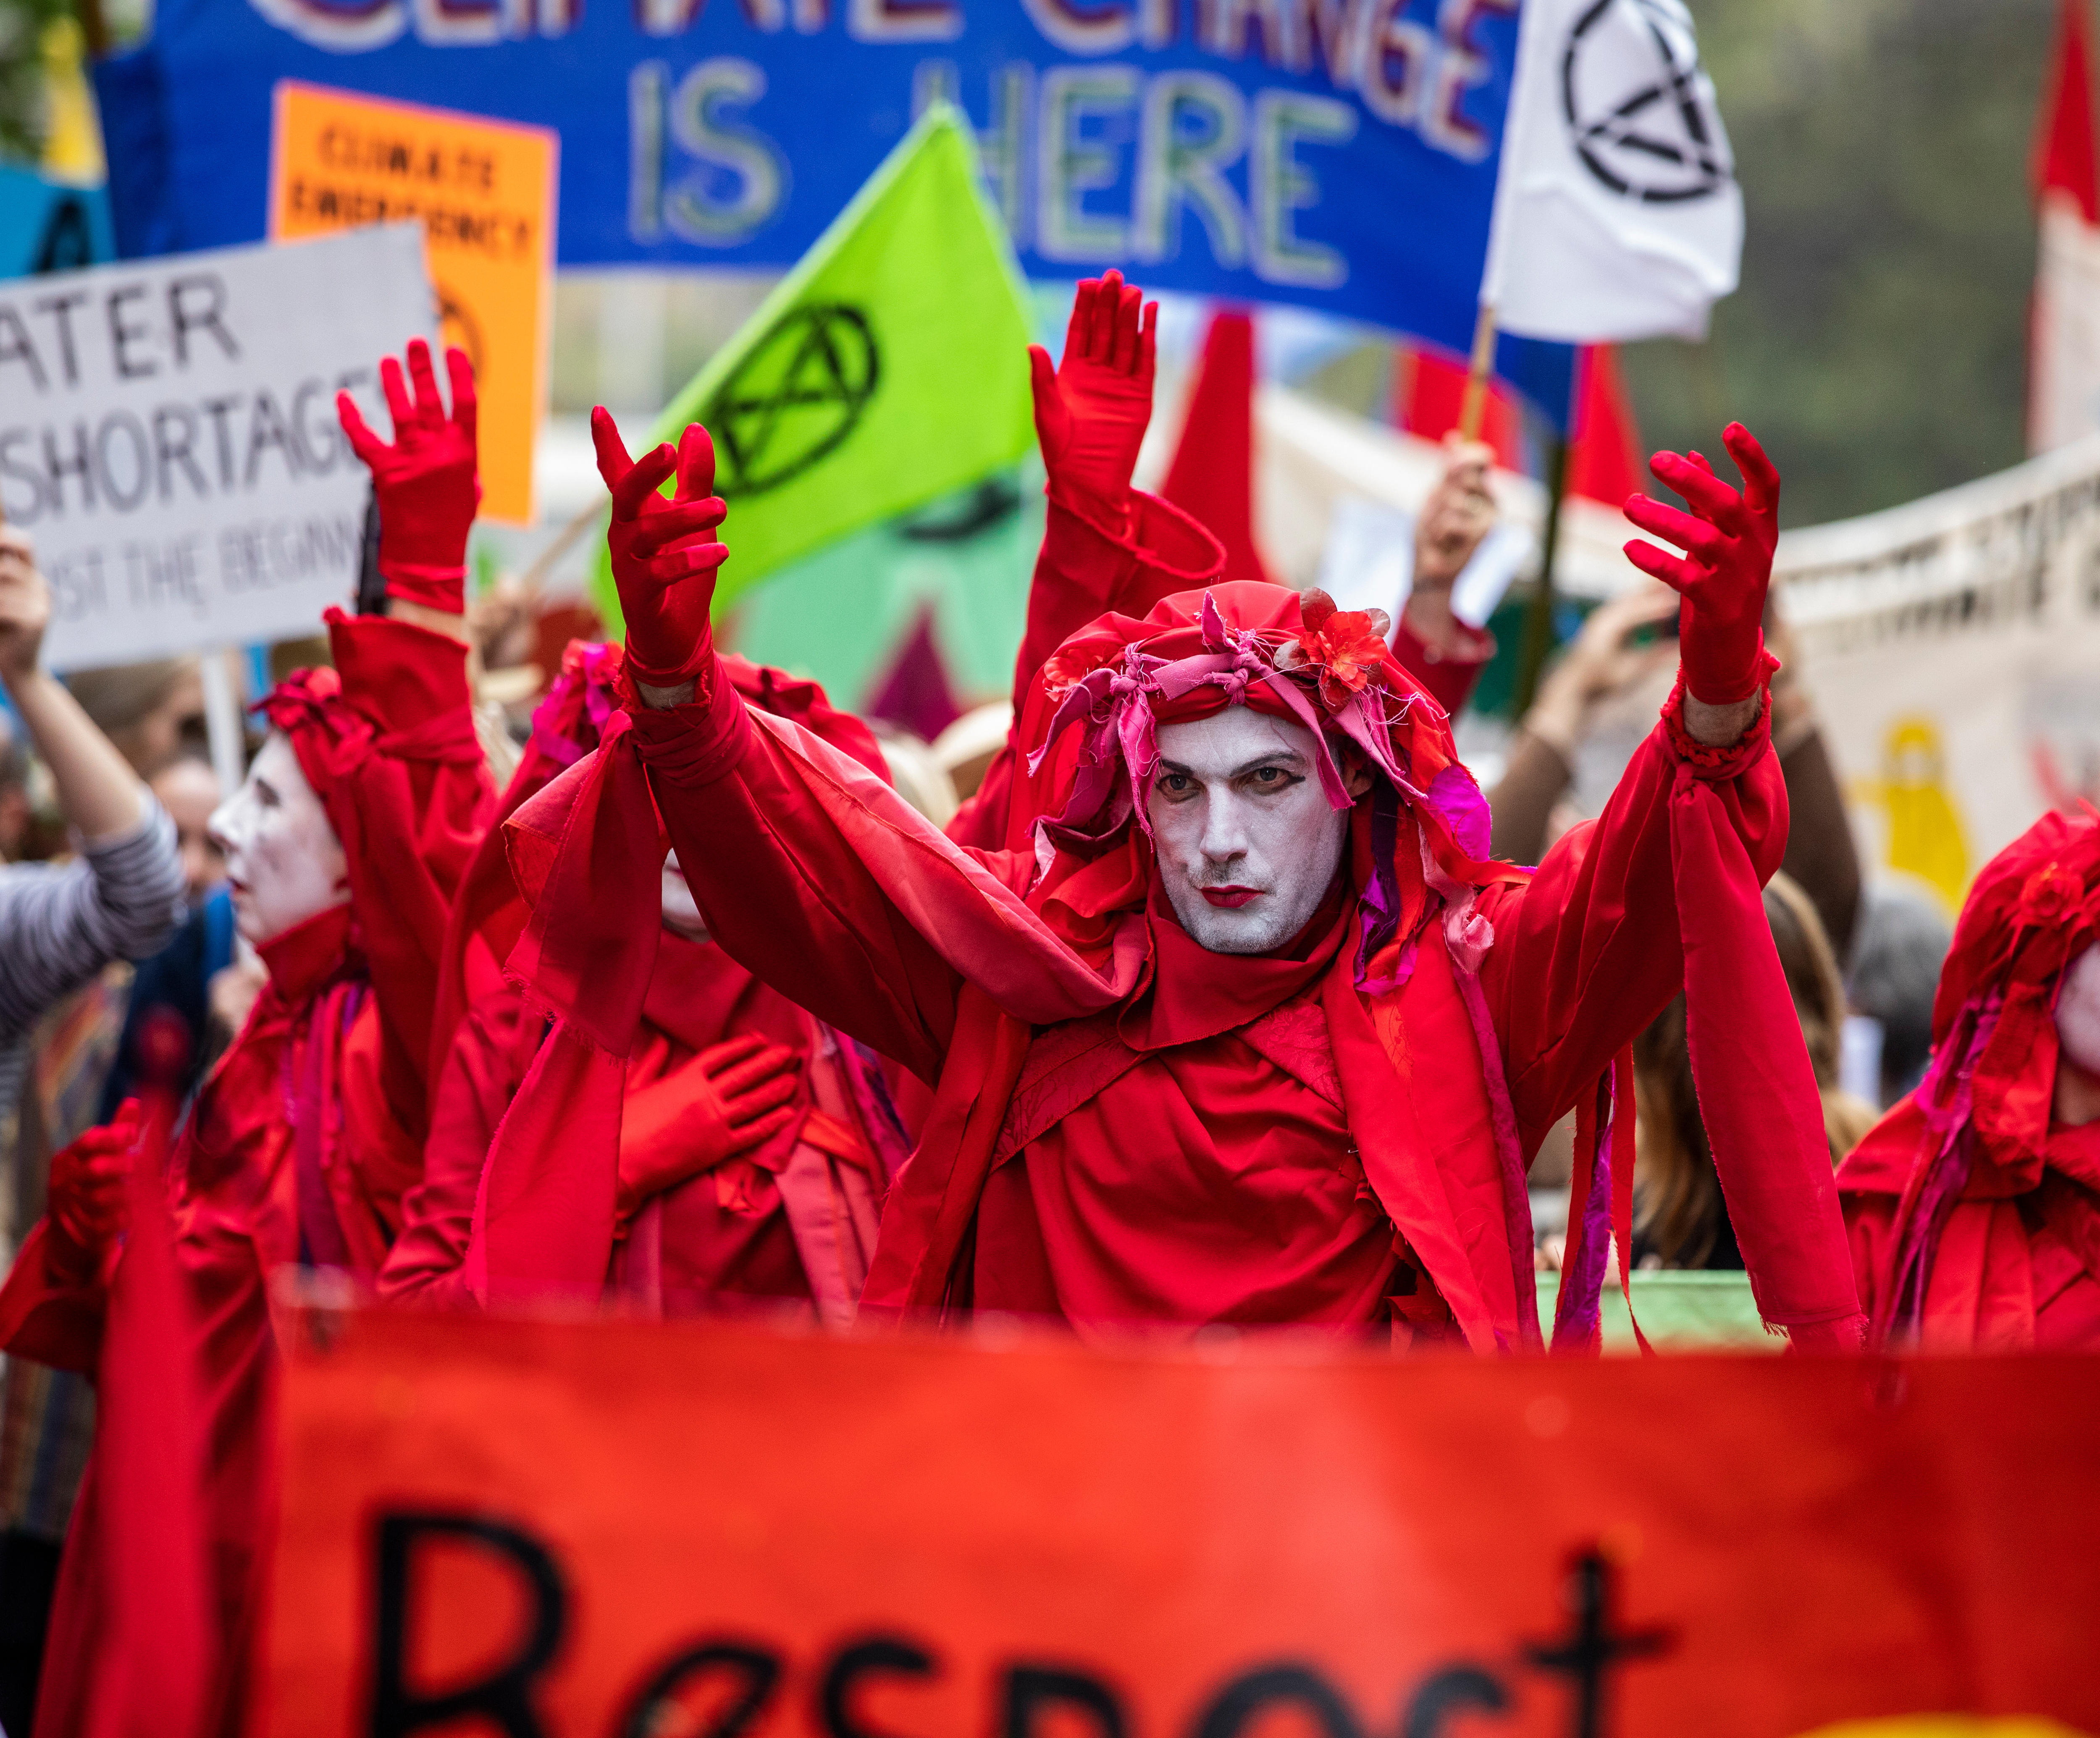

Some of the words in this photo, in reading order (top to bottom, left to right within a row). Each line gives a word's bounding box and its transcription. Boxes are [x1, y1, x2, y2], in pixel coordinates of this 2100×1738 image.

[316, 123, 495, 192] CLIMATE
[632, 57, 790, 244] IS
[913, 57, 1361, 289] HERE
[120, 528, 206, 612] THE
